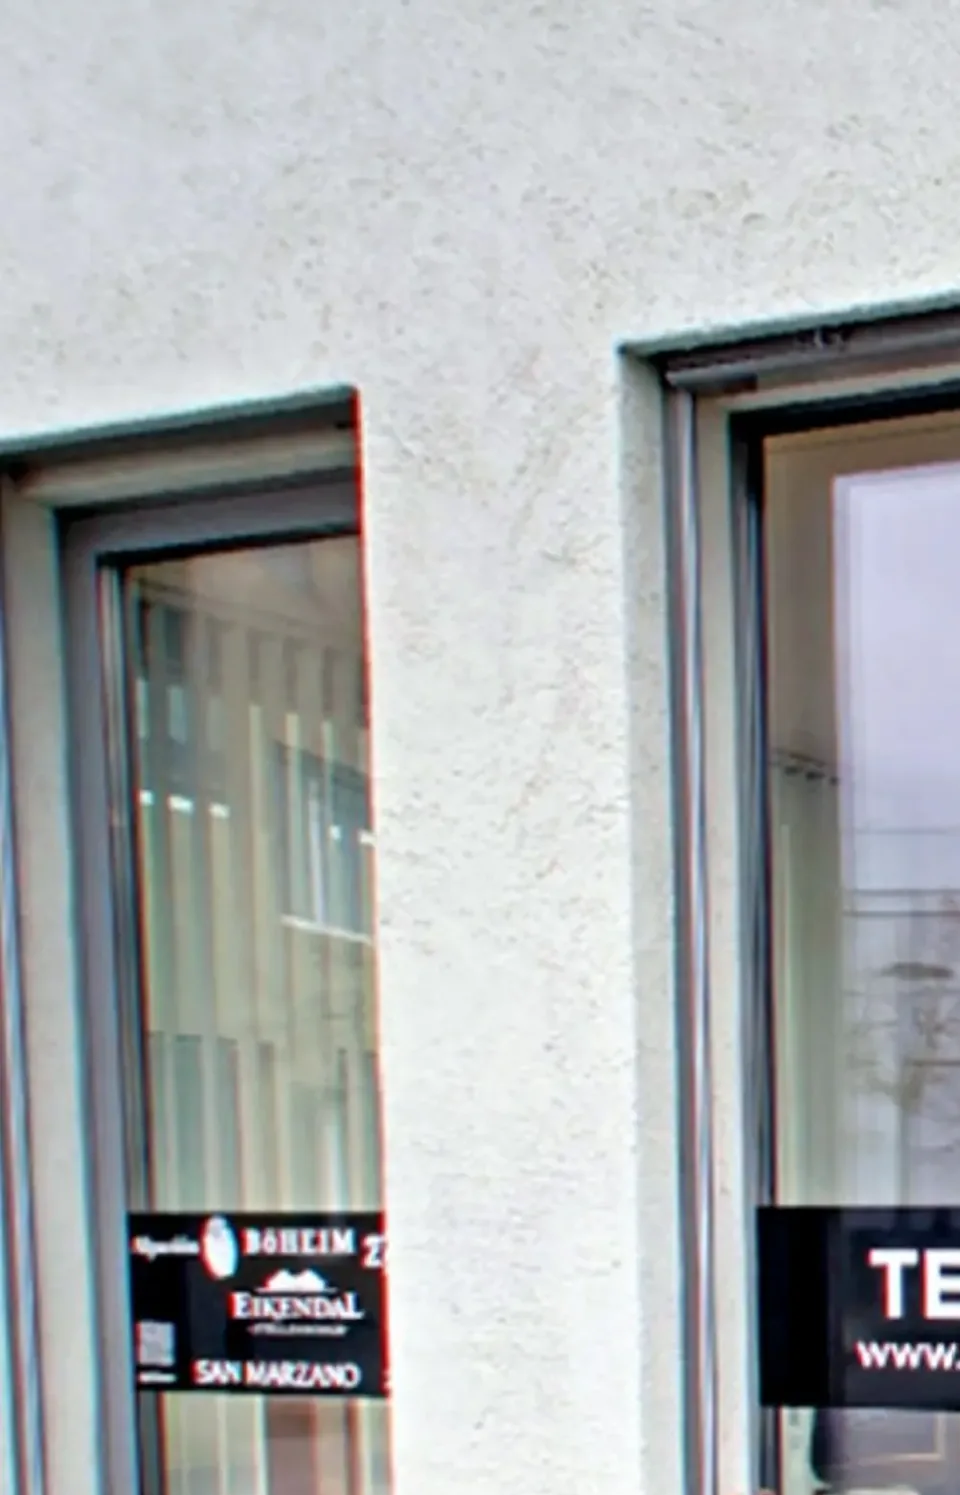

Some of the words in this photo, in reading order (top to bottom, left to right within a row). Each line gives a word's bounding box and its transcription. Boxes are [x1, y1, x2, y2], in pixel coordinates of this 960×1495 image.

[229, 1292, 365, 1319] EIKENDAL
[192, 1359, 242, 1385] SAN
[244, 1361, 361, 1388] MARZANO
